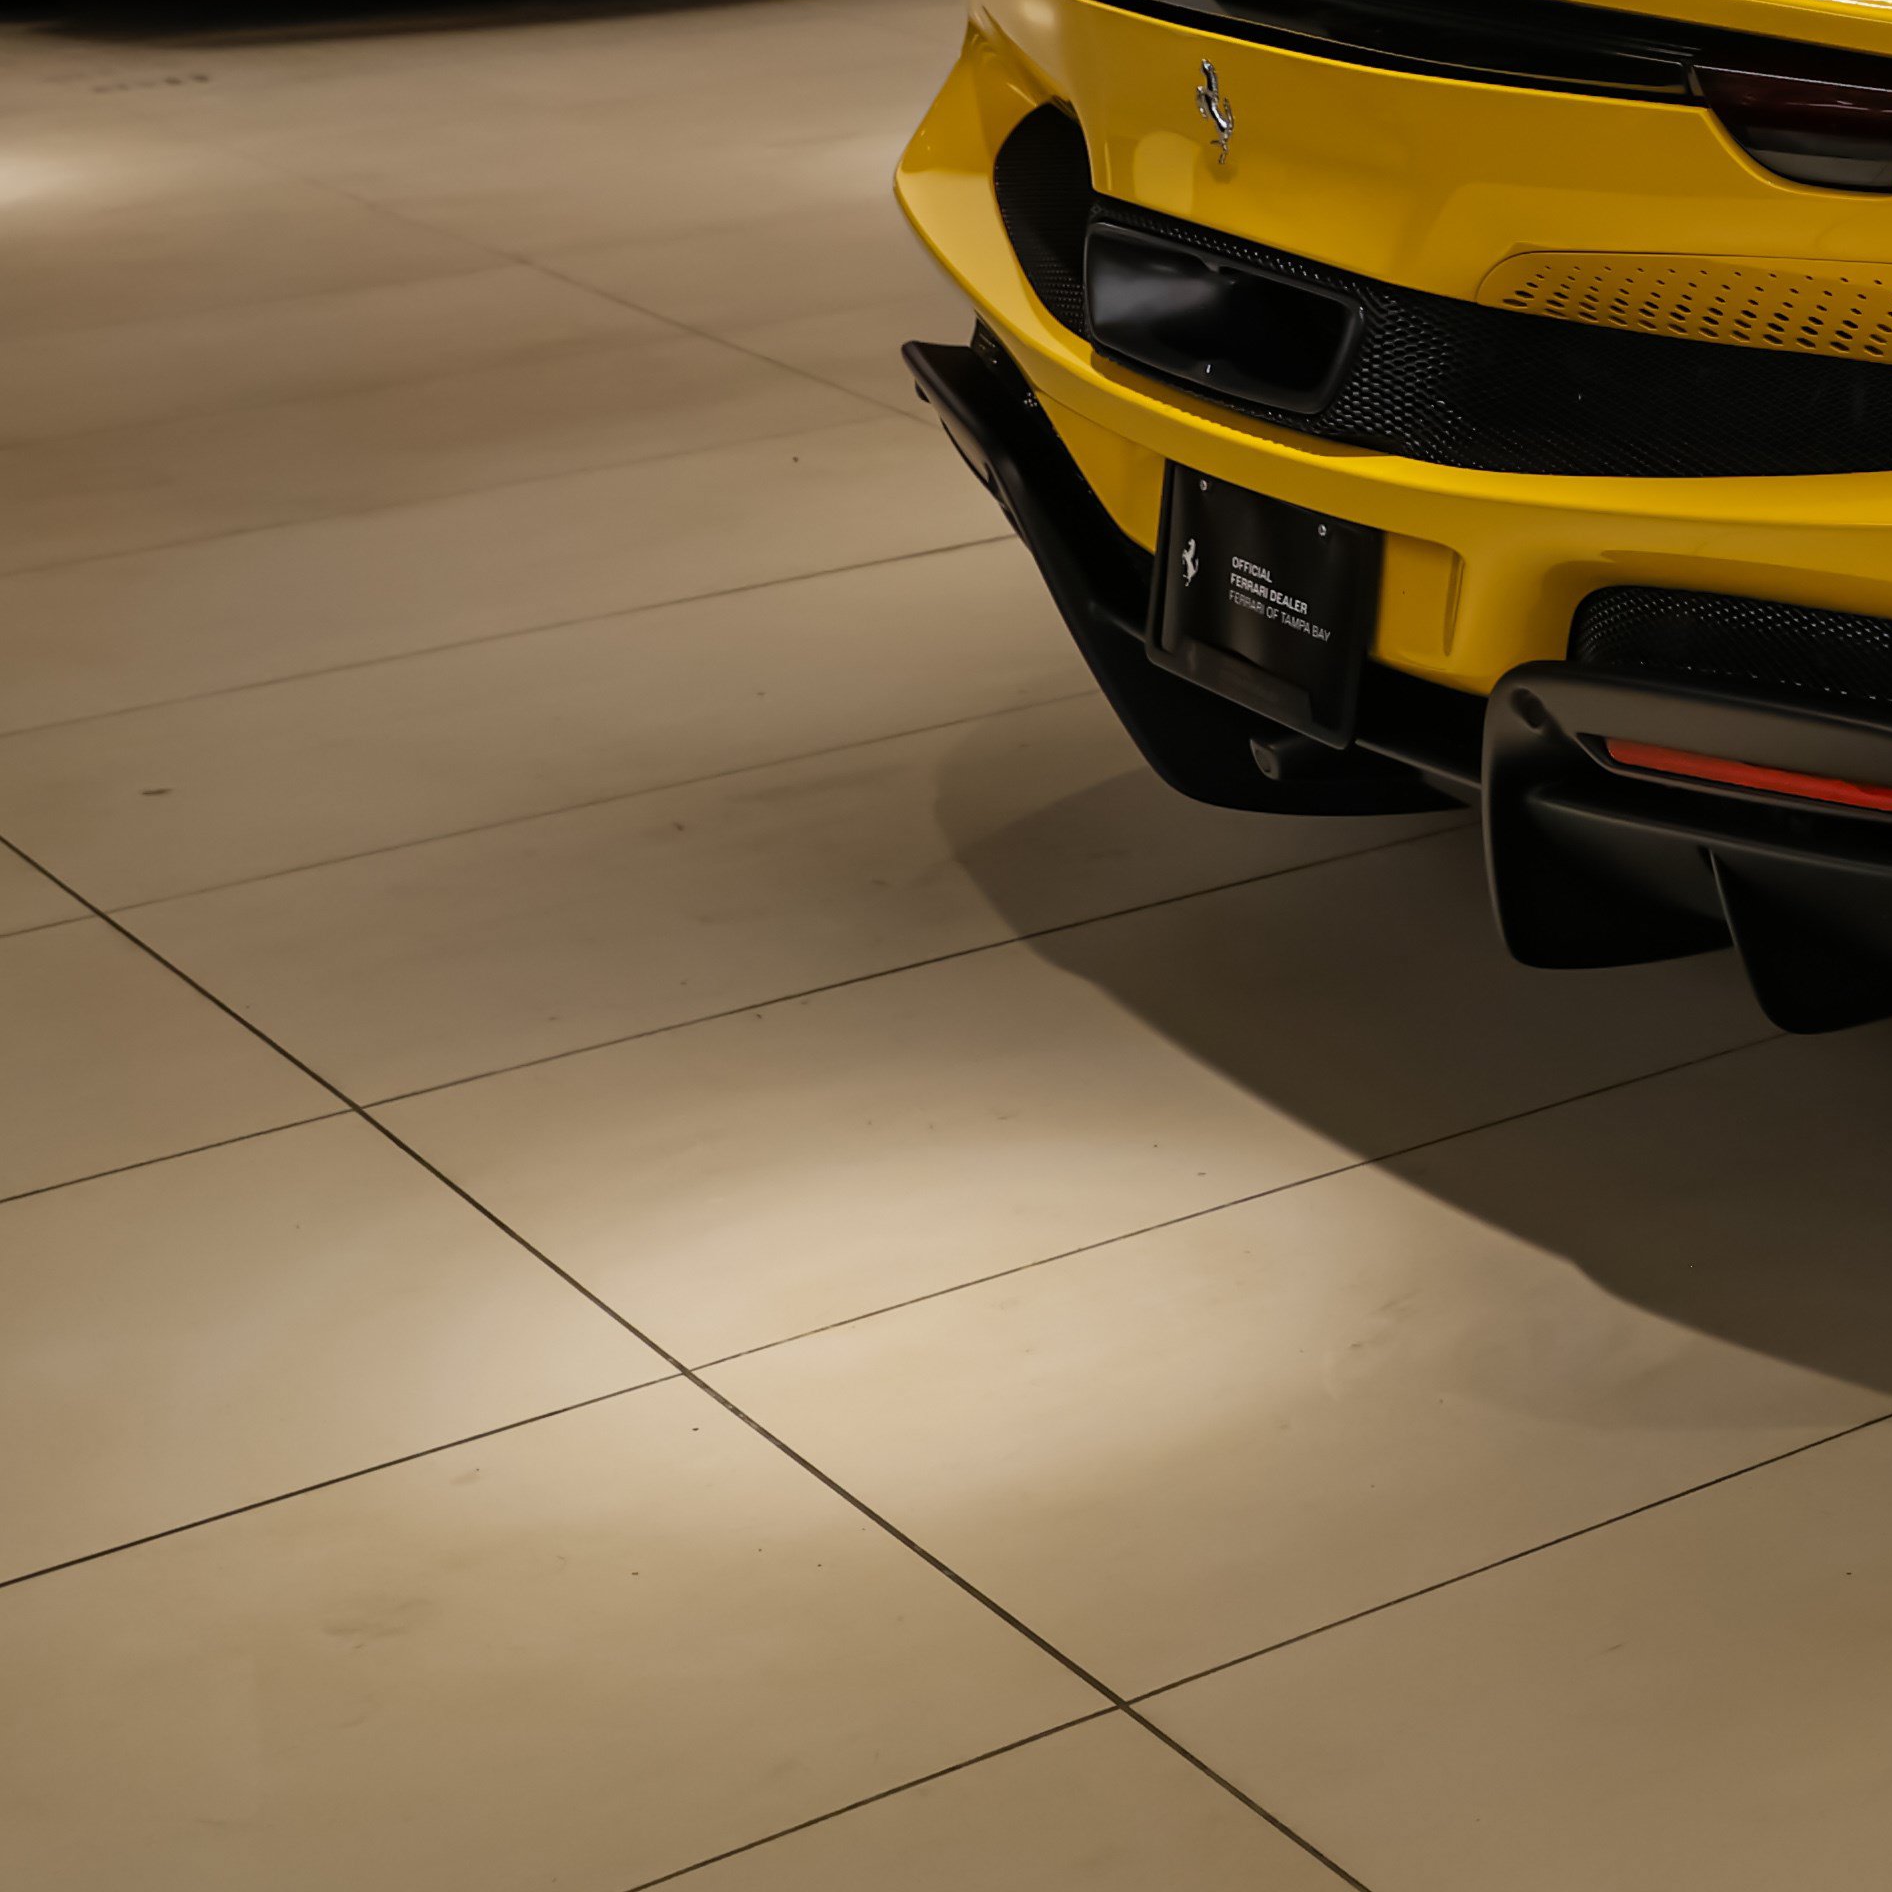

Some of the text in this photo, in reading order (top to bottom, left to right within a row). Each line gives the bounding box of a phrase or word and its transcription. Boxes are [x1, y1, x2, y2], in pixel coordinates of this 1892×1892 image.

[1231, 556, 1273, 584] OFFICIAL
[1228, 589, 1331, 643] FERRARI OF TAMPA BAY
[1230, 572, 1308, 616] FERRARI DEALER
